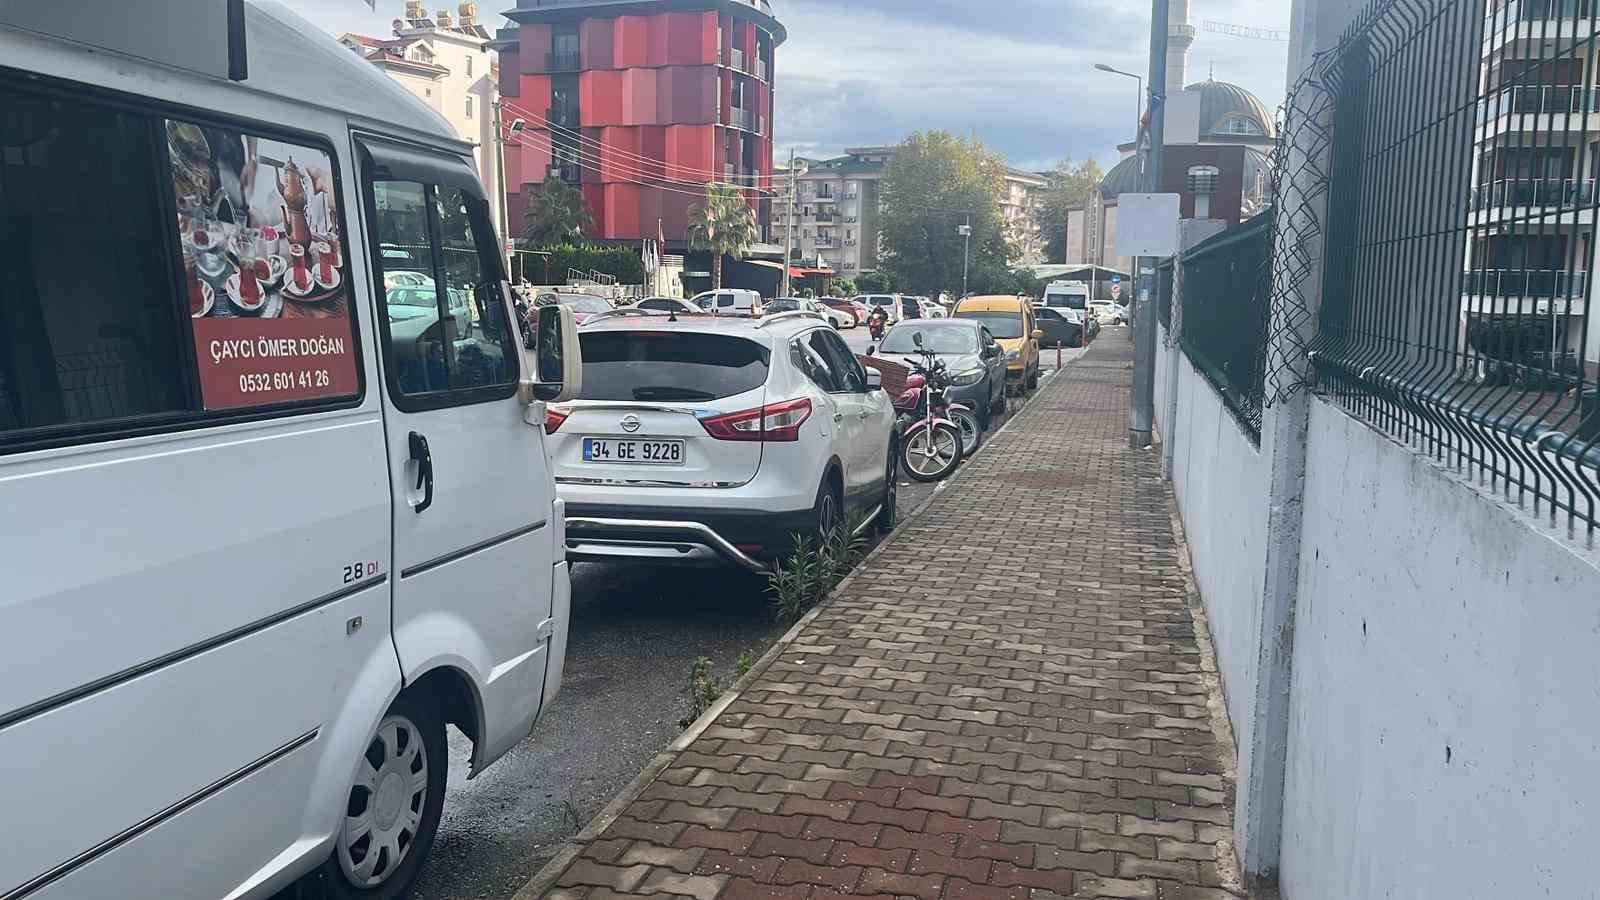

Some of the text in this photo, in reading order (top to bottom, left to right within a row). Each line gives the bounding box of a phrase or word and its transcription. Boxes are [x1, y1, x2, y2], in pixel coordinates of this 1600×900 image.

[210, 335, 345, 364] ÇAYCI ÖMER DOĞAN
[239, 369, 329, 392] 0532 601 41 26
[592, 441, 609, 458] 34
[617, 442, 636, 459] GE
[642, 443, 680, 460] 9228
[367, 561, 379, 576] DI
